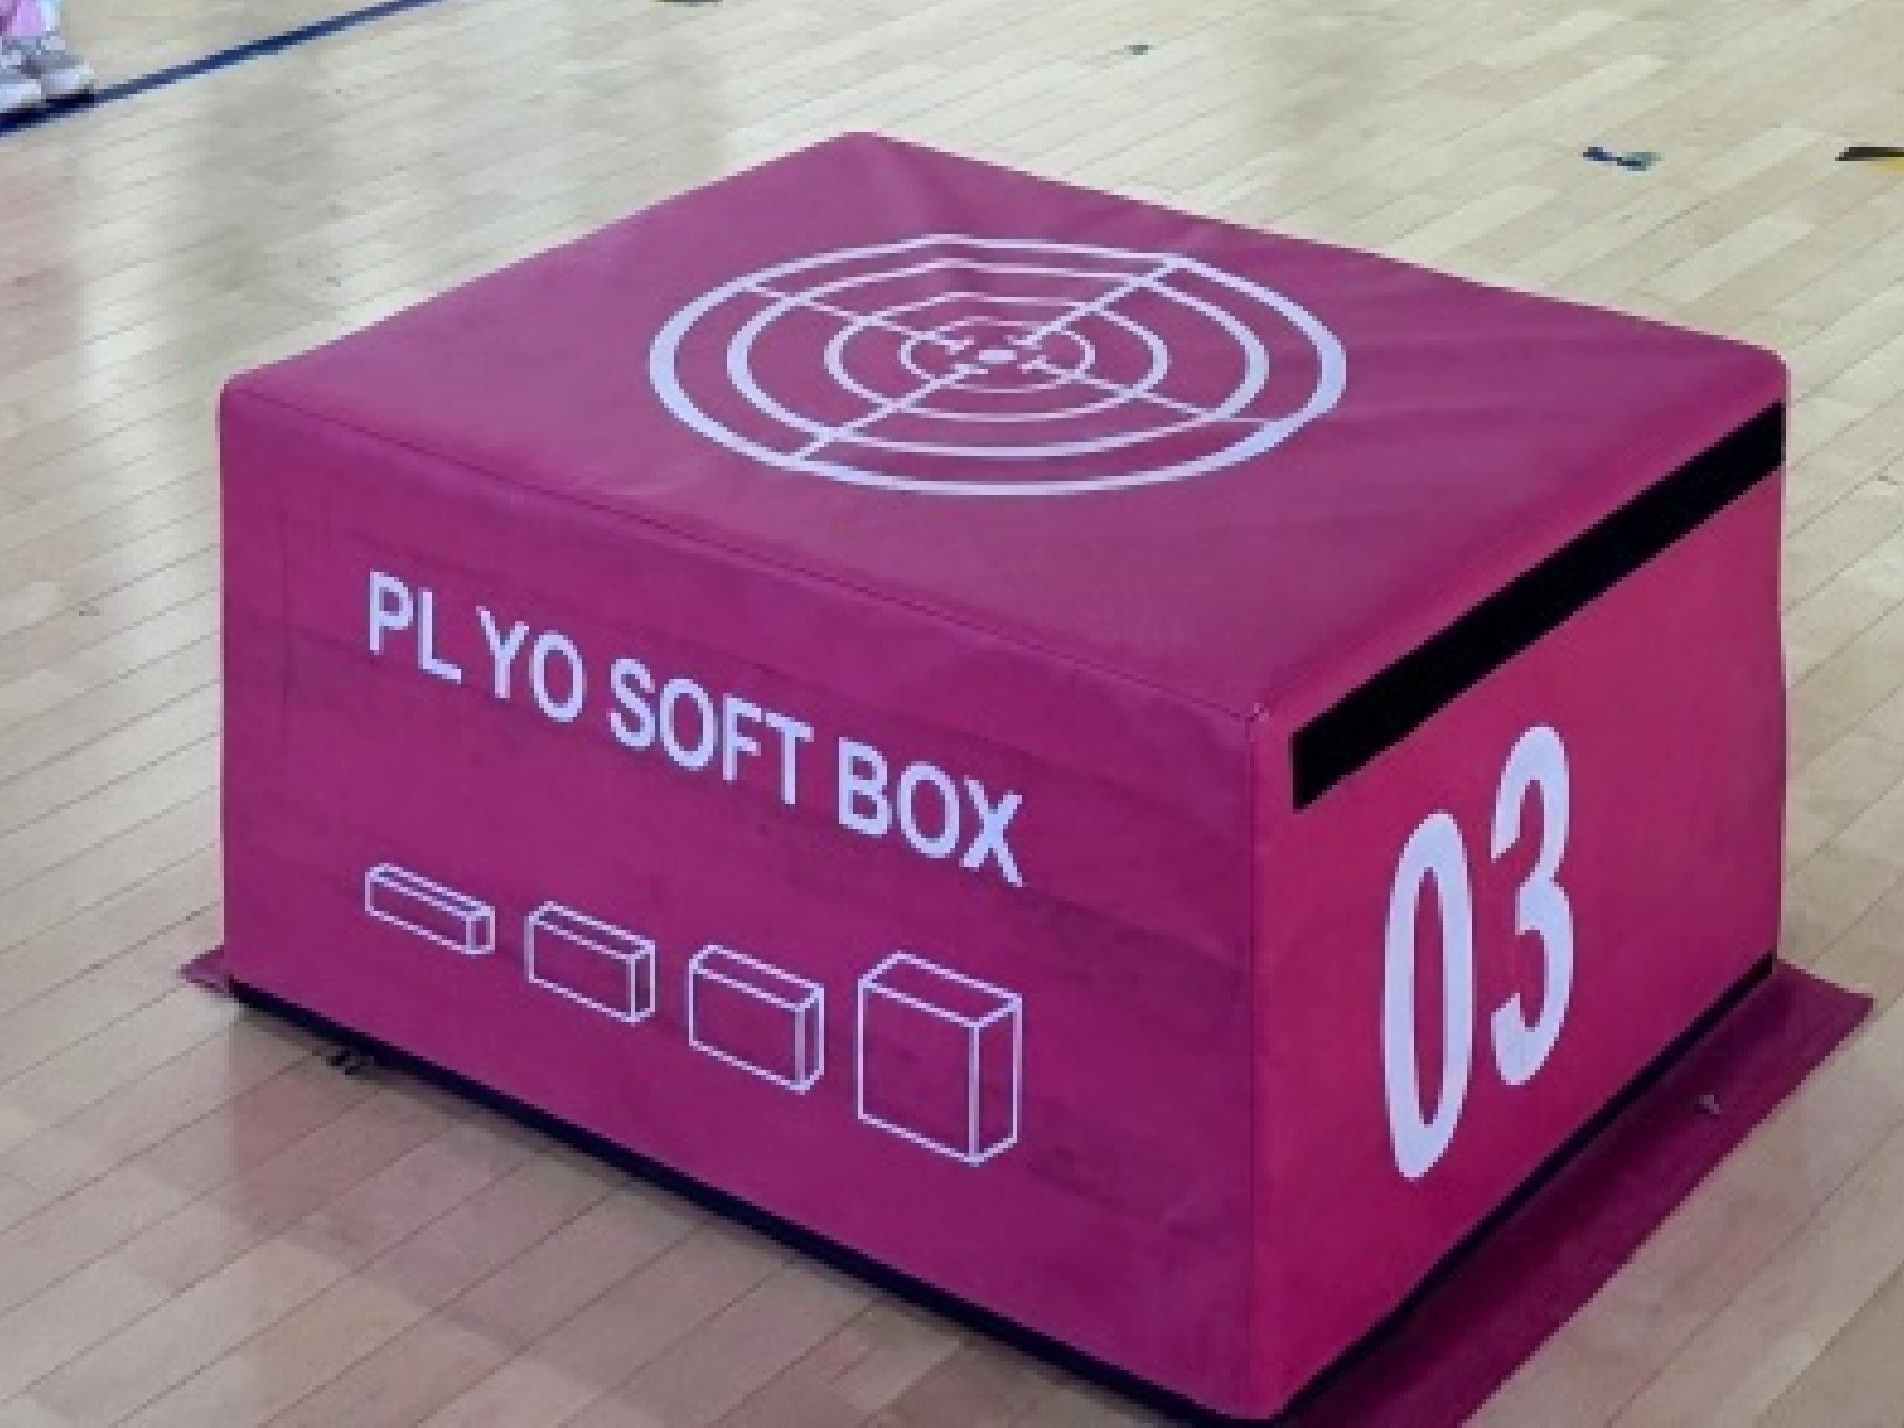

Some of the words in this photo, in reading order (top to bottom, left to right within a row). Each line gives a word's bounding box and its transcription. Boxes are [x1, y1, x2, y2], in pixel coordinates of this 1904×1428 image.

[608, 656, 814, 807] SOFT
[836, 735, 1025, 890] BOX
[1382, 724, 1576, 1180] 03
